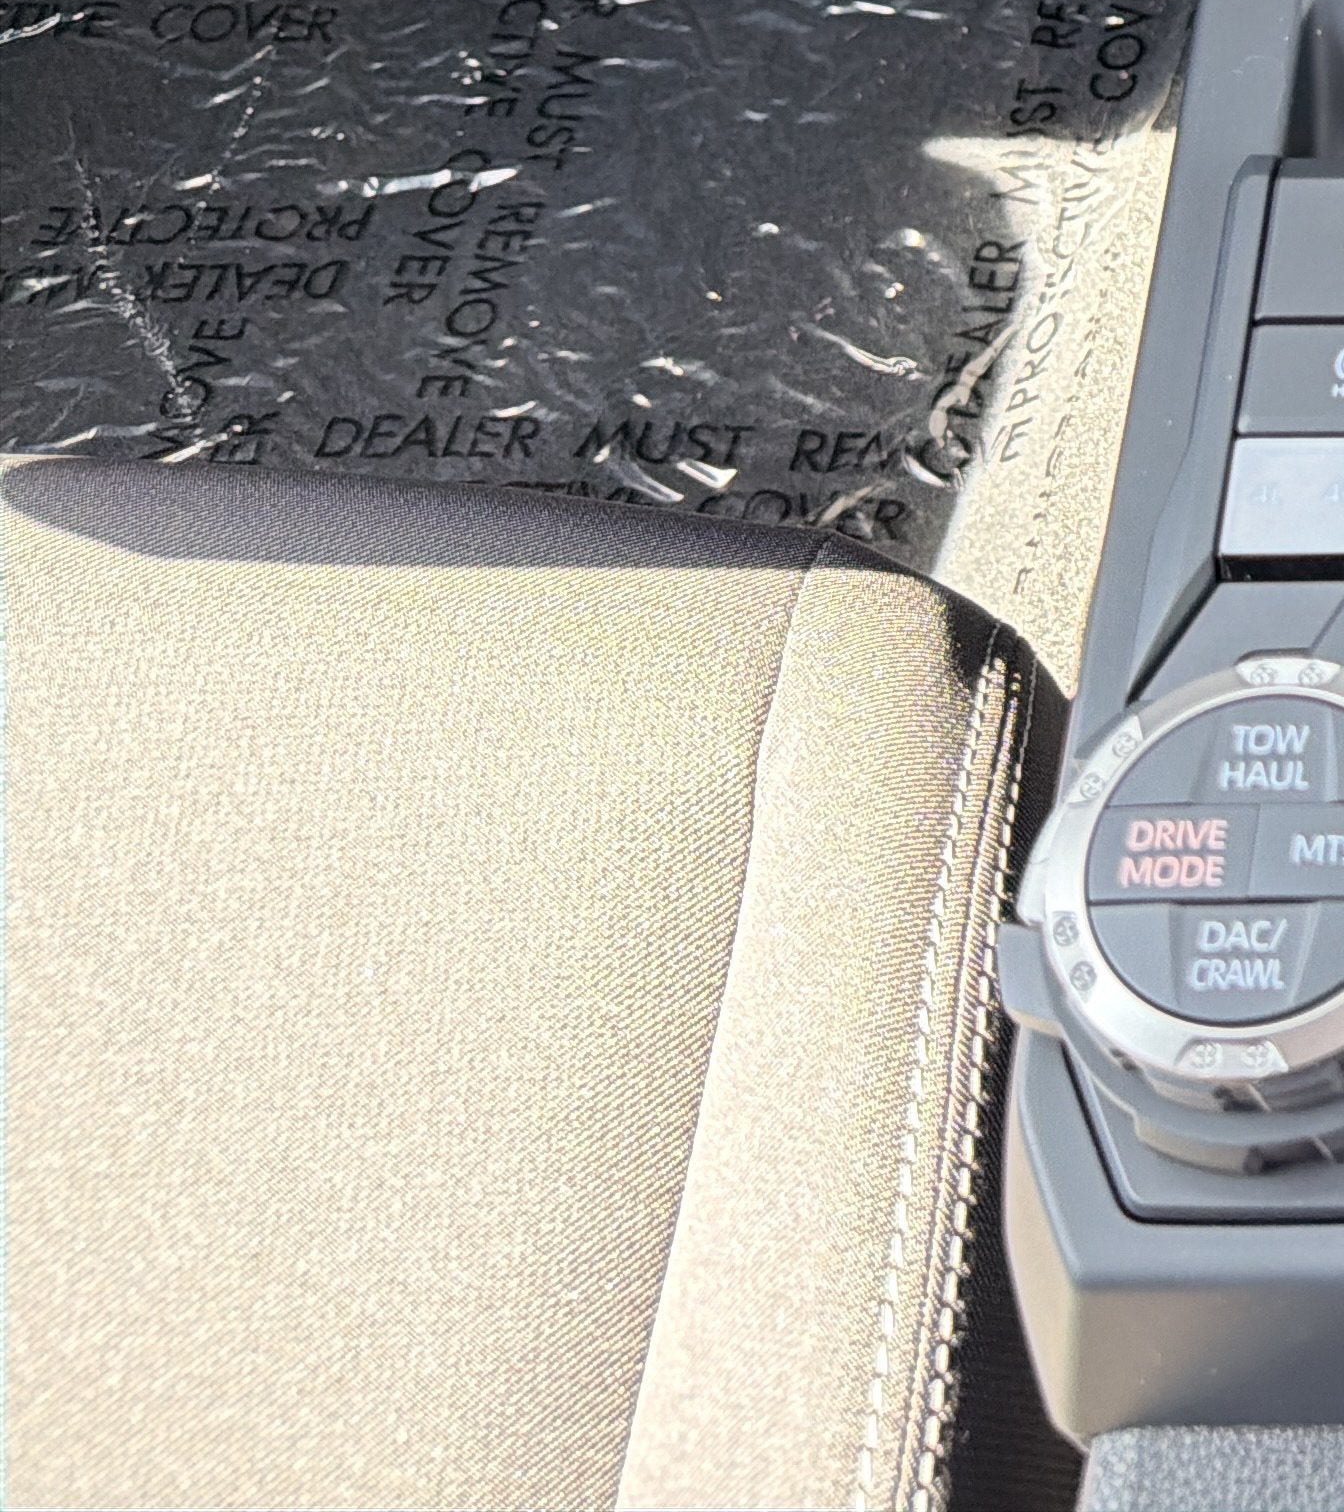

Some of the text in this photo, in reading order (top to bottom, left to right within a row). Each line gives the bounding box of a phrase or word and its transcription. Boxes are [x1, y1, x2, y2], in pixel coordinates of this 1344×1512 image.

[150, 1, 340, 51] COVER
[524, 50, 602, 172] MUST
[414, 199, 548, 399] REMOVE
[313, 414, 543, 461] DEALER
[572, 421, 757, 467] MUST
[1232, 723, 1310, 756] TOW
[1217, 760, 1310, 789] HAUL
[1125, 819, 1228, 851] DRIVE
[1118, 855, 1225, 888] MODE
[1199, 918, 1288, 949] DAC/
[1190, 959, 1287, 991] CRAWL
